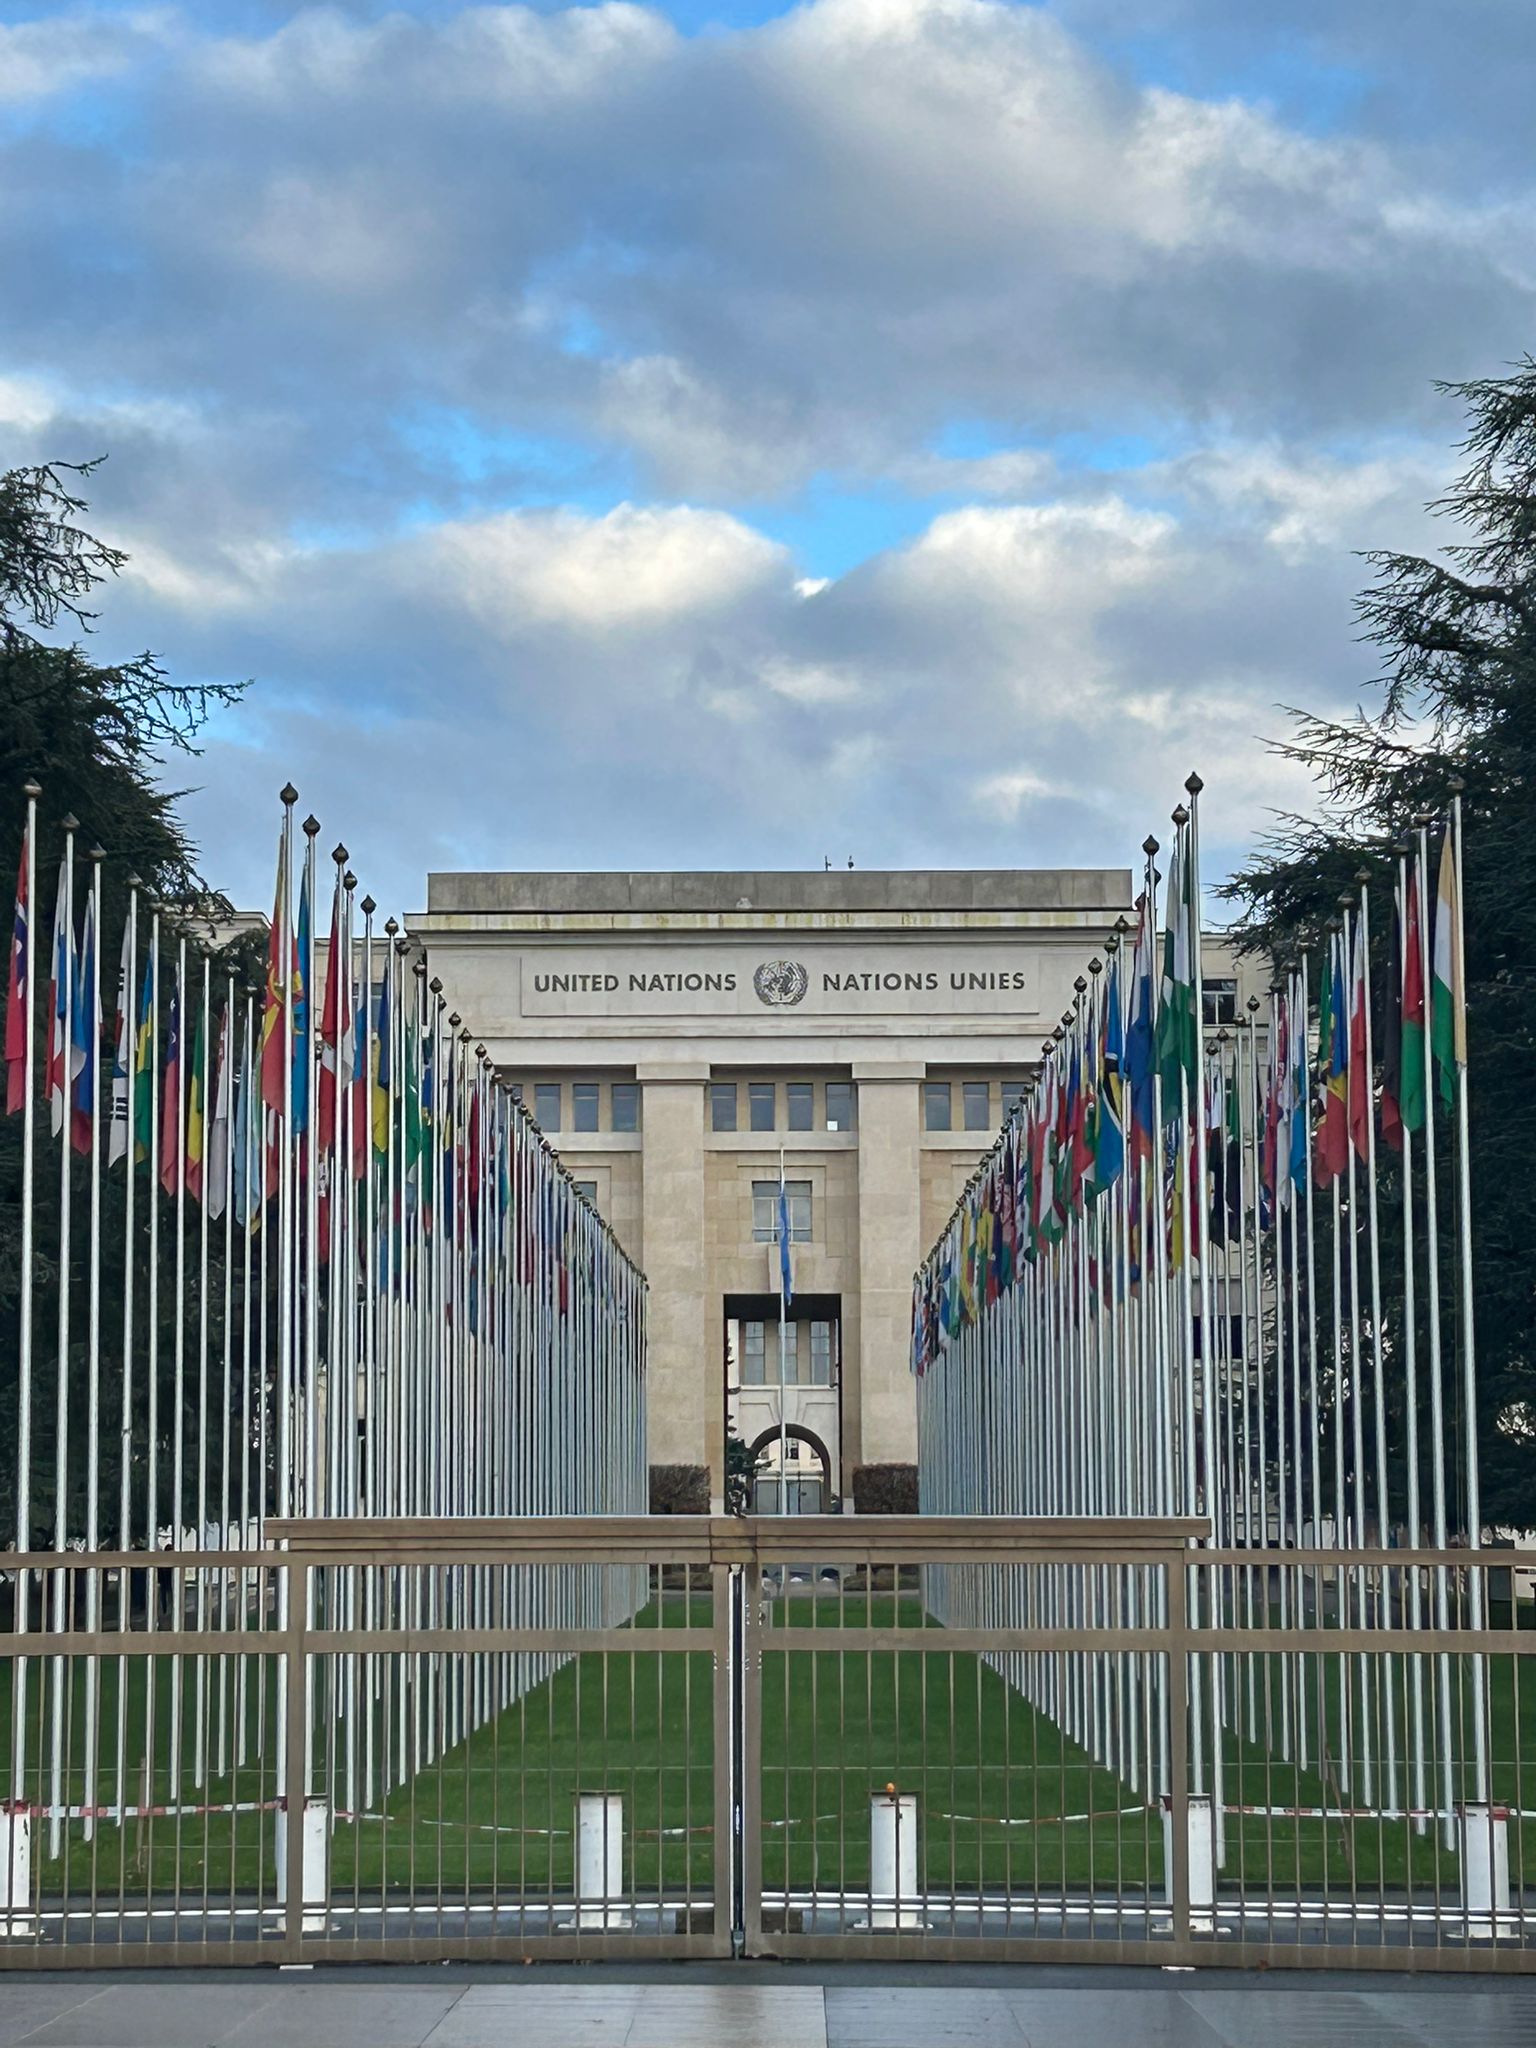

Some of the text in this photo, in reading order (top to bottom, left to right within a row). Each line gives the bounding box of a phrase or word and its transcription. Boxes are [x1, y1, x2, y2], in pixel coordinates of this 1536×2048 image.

[534, 973, 737, 992] UNITED NATIONS
[823, 972, 1025, 991] NATIONS UNIES
